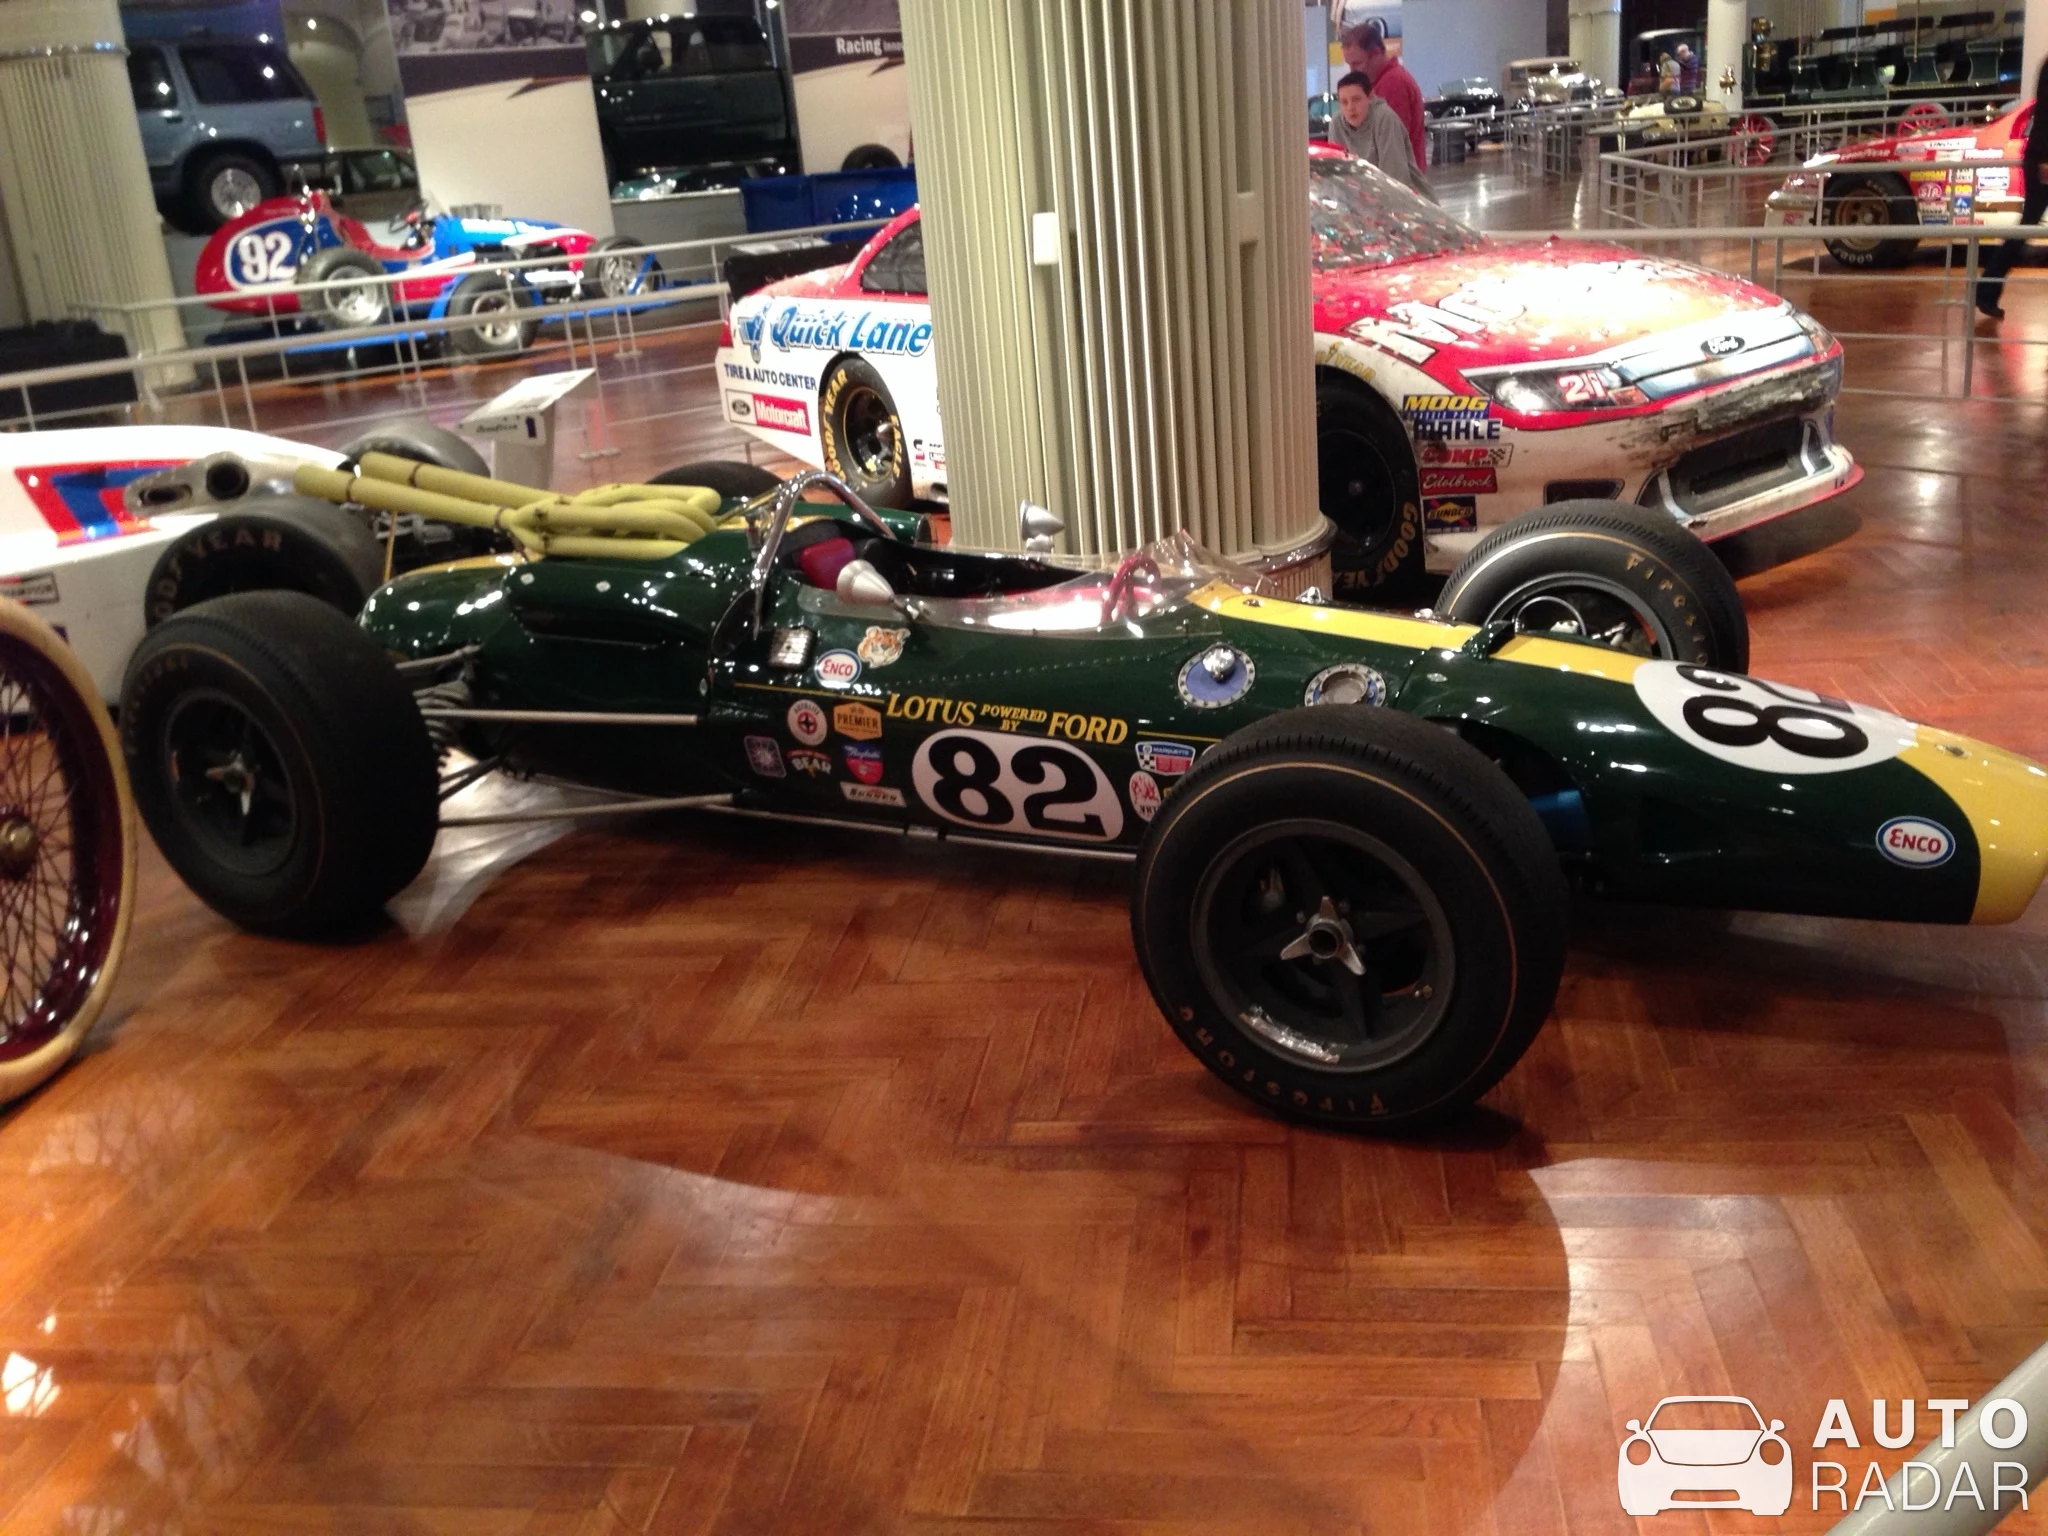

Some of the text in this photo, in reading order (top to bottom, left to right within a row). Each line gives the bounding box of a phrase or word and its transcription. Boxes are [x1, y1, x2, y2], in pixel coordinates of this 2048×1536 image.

[835, 36, 882, 56] Racing
[238, 230, 296, 283] 92
[770, 304, 933, 357] Quick Lane
[724, 363, 819, 392] TIRE & AUTO CENTER
[1405, 395, 1489, 411] MOOG
[755, 400, 808, 430] Motorcraft
[1414, 420, 1501, 441] MAHLE
[1422, 447, 1489, 464] COMP
[1422, 473, 1494, 490] Edelbrock
[1427, 506, 1474, 519] SUNOCO
[821, 659, 854, 677] ENCO
[837, 713, 879, 730] PREMIER
[886, 693, 1128, 745] LOTUS POWERED BY FORD
[928, 736, 1107, 837] 82
[1889, 827, 1942, 855] ENCO
